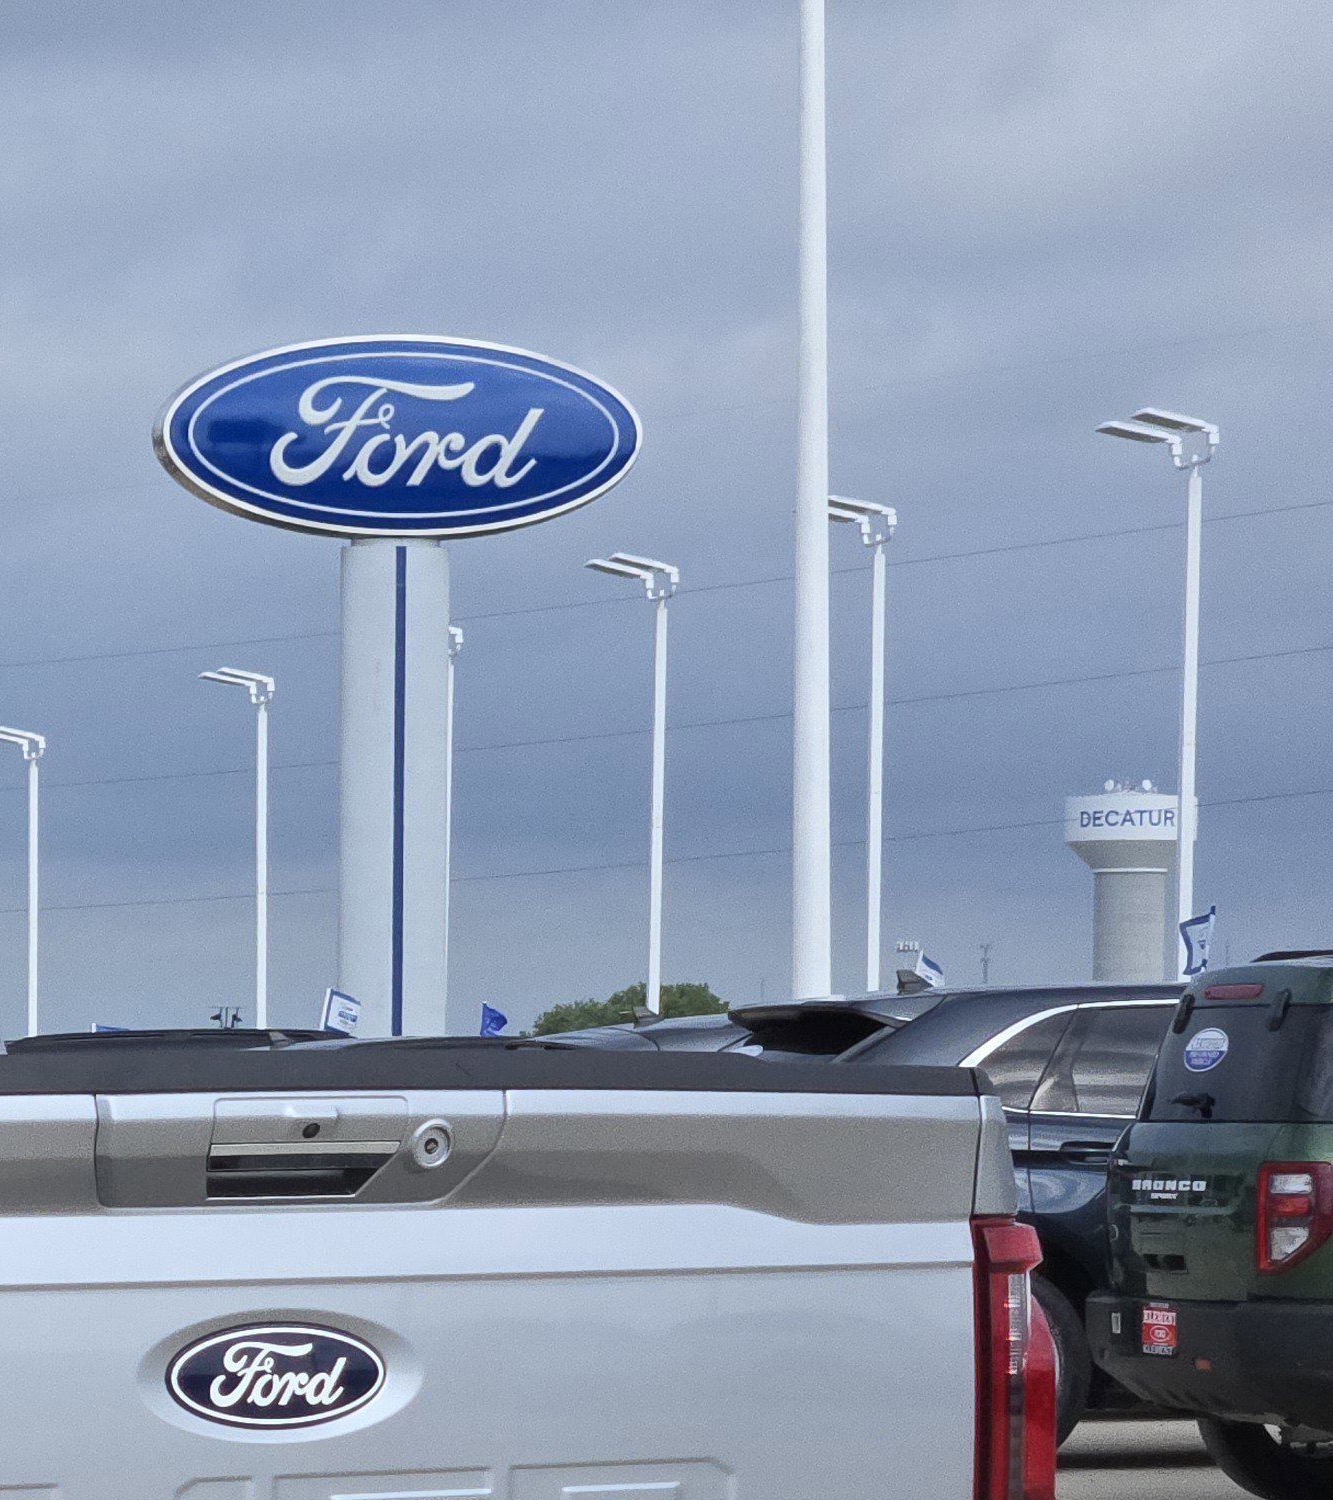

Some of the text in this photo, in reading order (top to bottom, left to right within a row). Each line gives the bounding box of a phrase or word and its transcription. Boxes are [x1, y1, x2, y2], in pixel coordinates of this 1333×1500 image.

[269, 375, 545, 488] Ford
[1079, 809, 1176, 828] DECATUR
[209, 1341, 347, 1408] Ford
